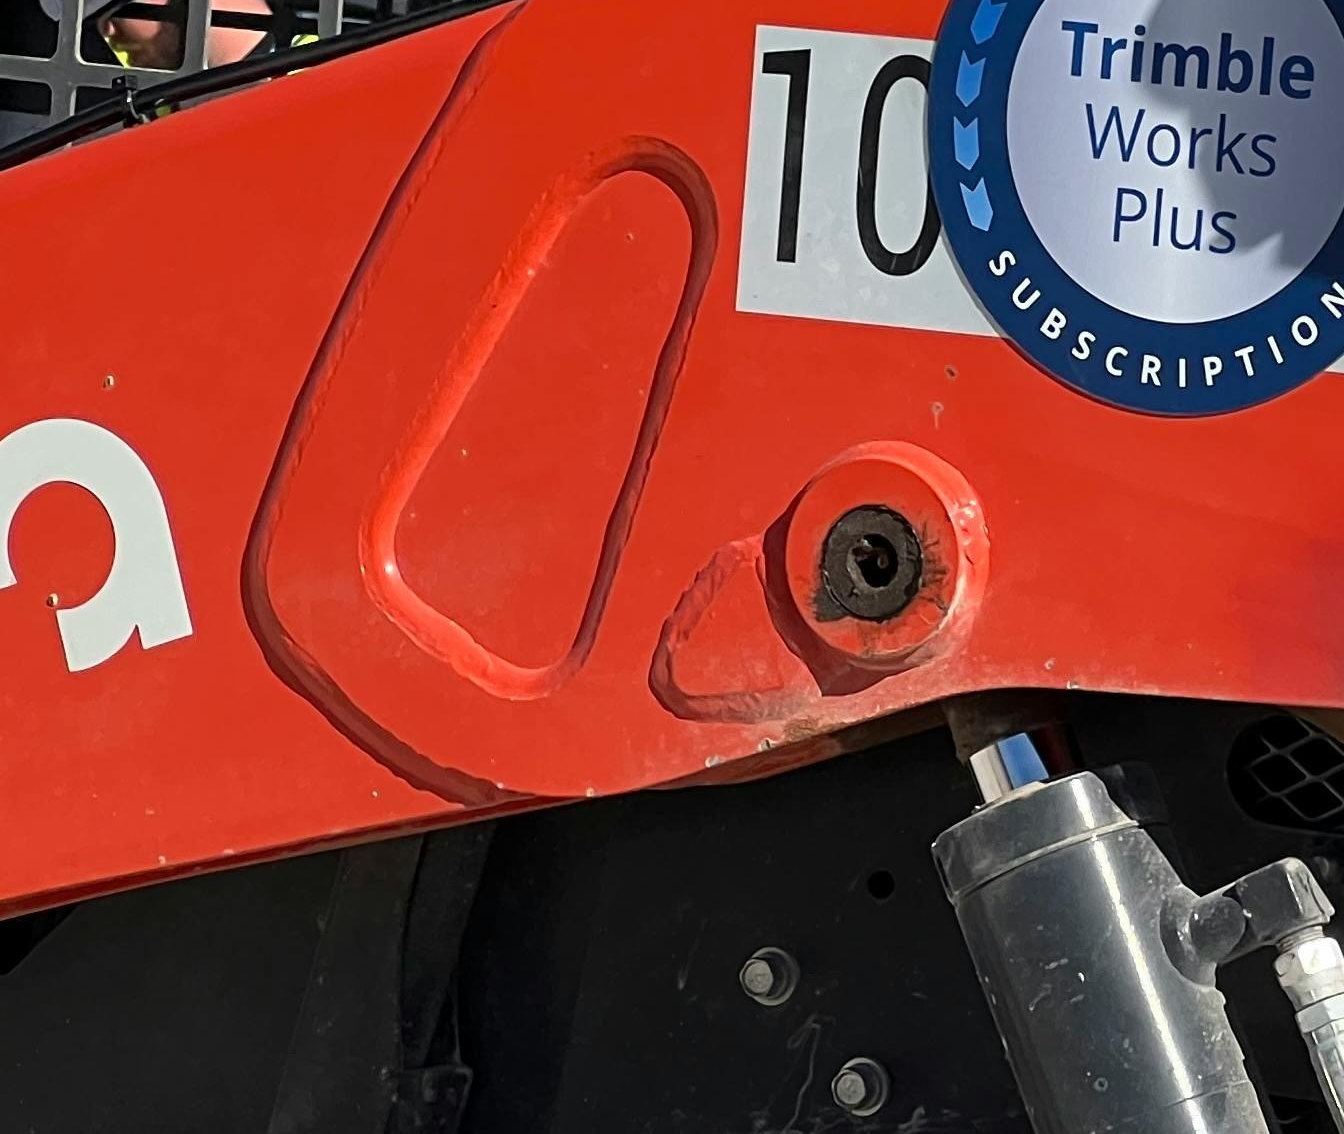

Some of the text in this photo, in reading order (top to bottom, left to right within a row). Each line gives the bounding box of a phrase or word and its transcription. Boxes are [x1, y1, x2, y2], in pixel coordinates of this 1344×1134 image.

[1060, 20, 1316, 103] Trimble
[1084, 101, 1278, 178] Works
[1111, 187, 1239, 256] Plus
